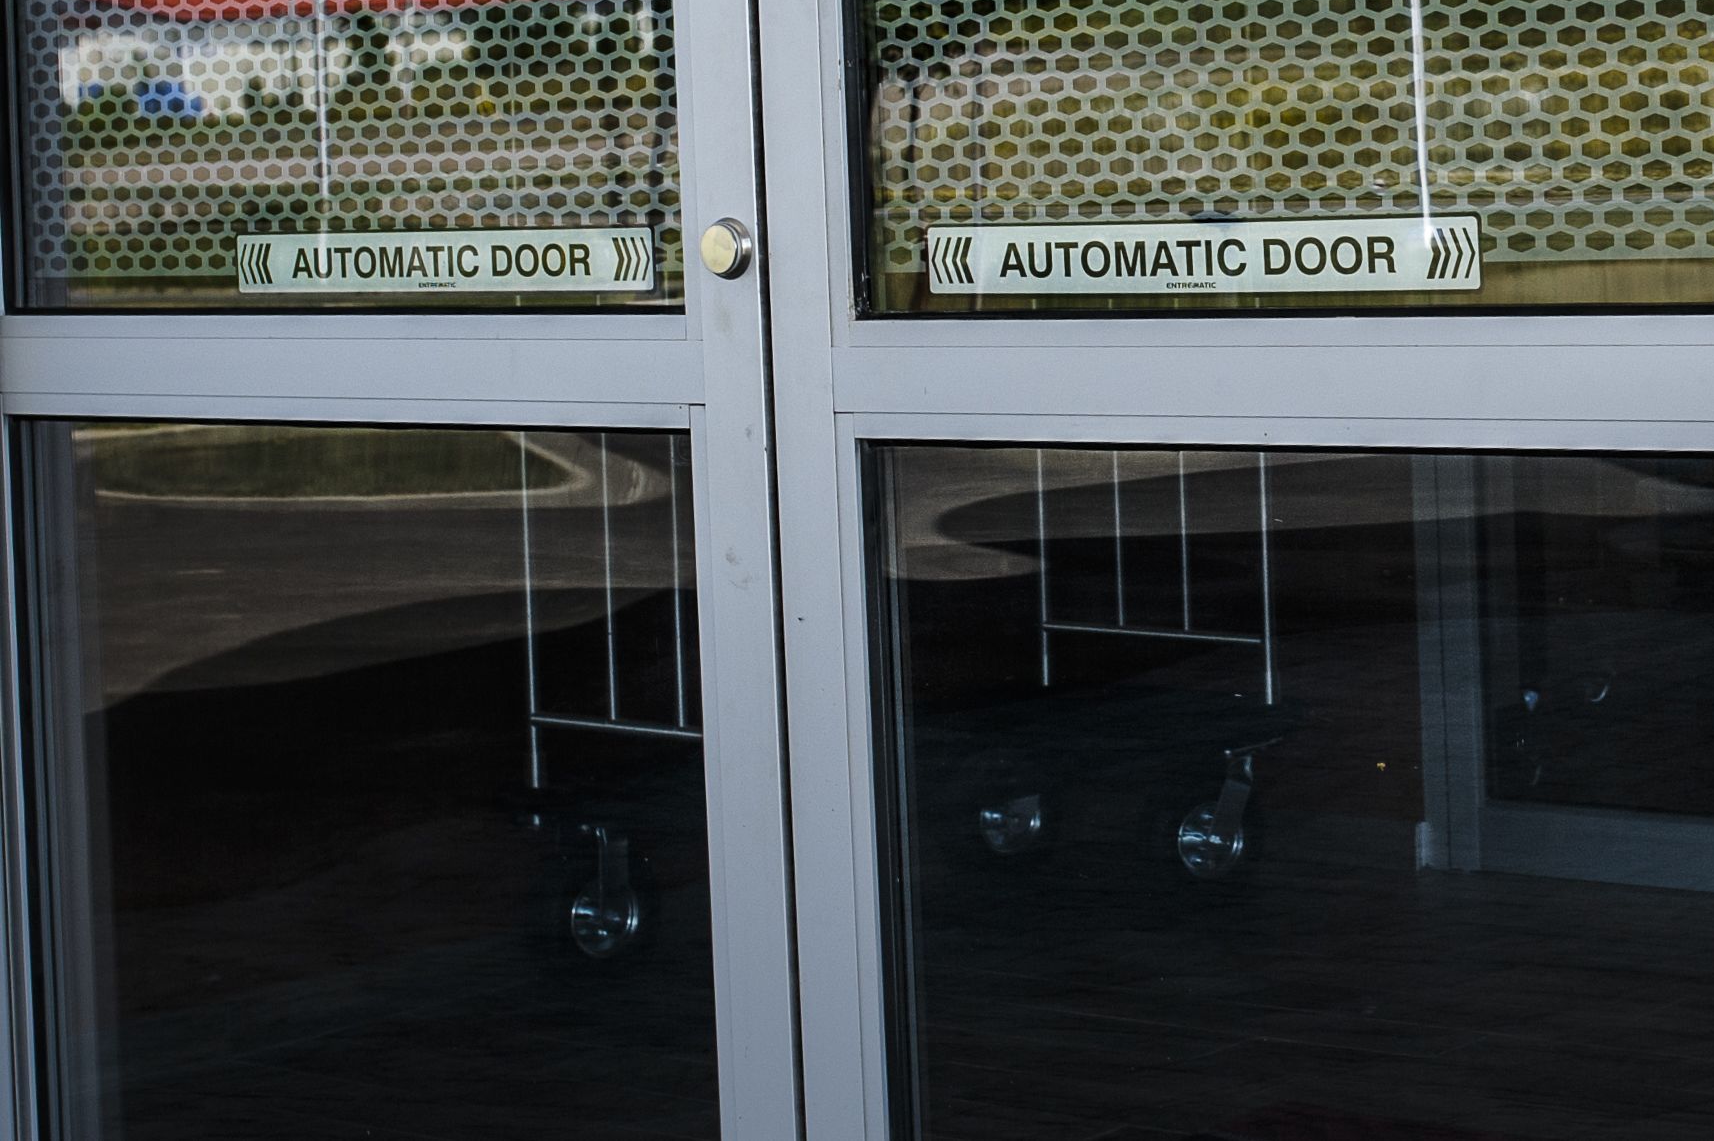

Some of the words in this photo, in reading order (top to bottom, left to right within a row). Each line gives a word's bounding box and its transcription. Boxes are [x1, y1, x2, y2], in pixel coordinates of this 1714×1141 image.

[292, 244, 479, 278] AUTOMATIC
[491, 243, 591, 276] DOOR
[1000, 238, 1247, 278] AUTOMATIC
[1263, 236, 1396, 275] DOOR
[1166, 281, 1216, 289] ENTREMATIC
